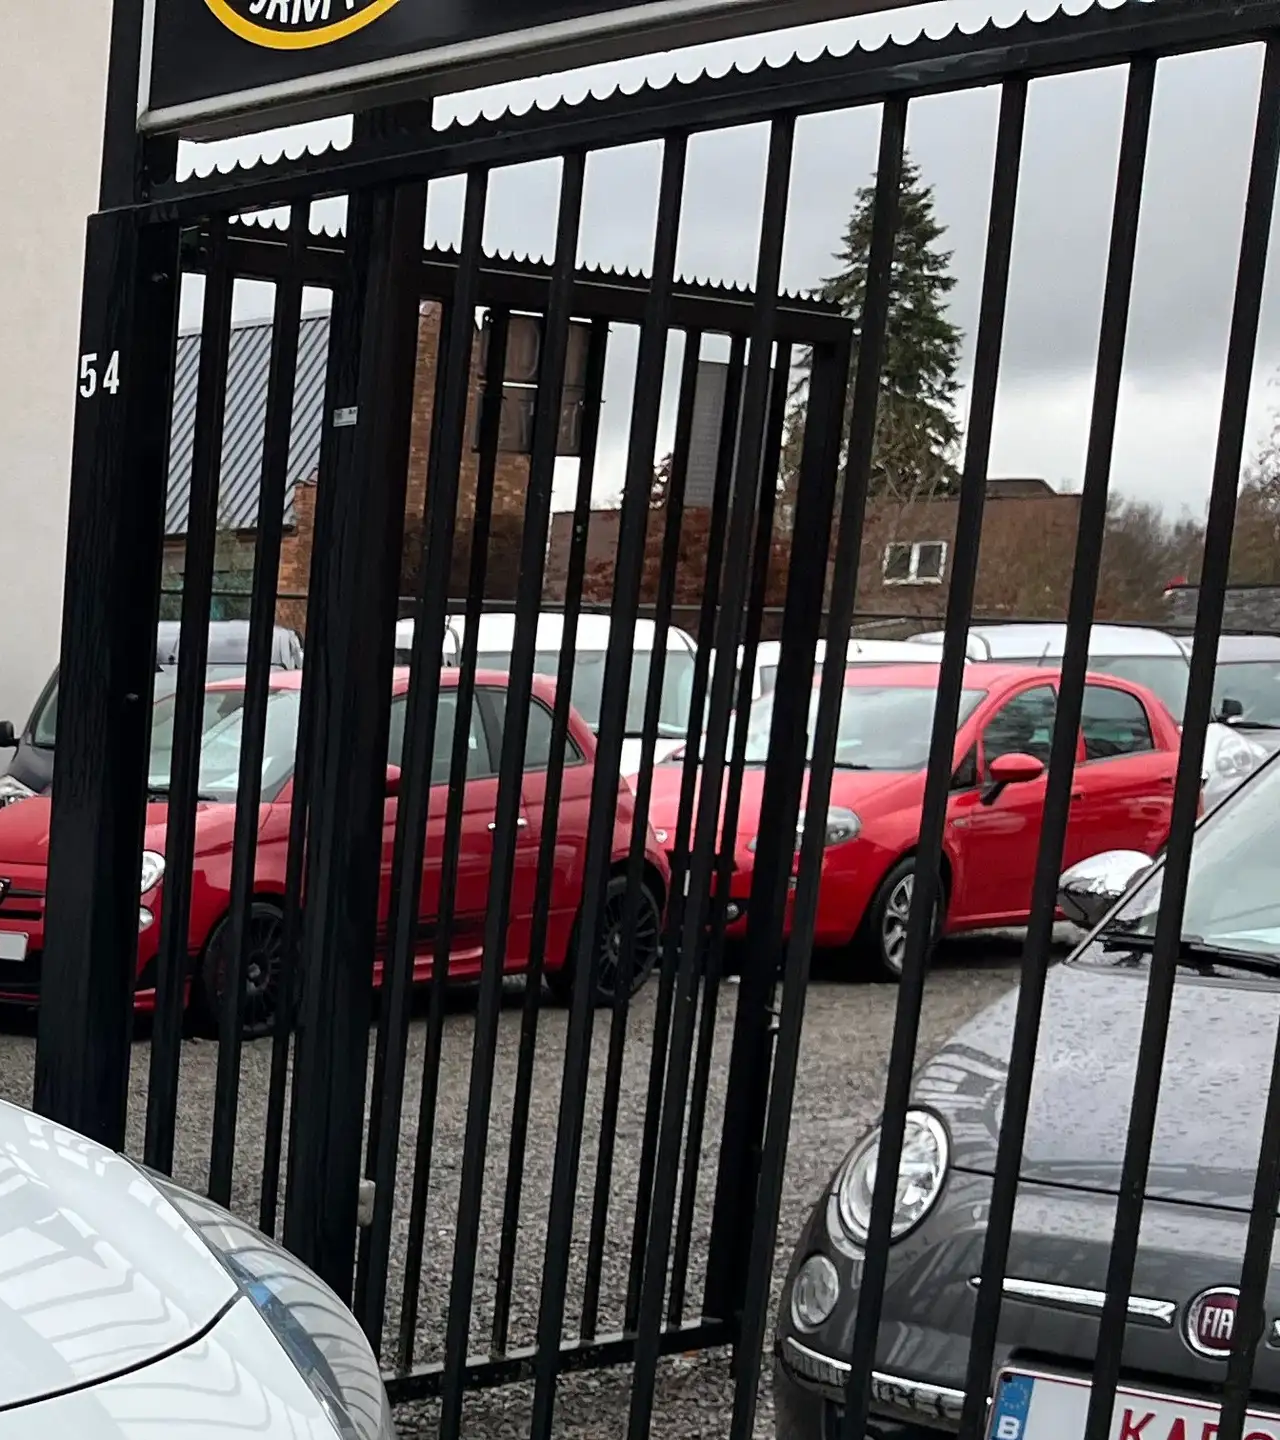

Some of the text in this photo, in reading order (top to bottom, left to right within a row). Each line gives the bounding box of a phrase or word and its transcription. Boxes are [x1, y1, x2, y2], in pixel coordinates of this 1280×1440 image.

[79, 350, 120, 398] 54
[1201, 1306, 1234, 1341] FIA
[996, 1414, 1020, 1440] B
